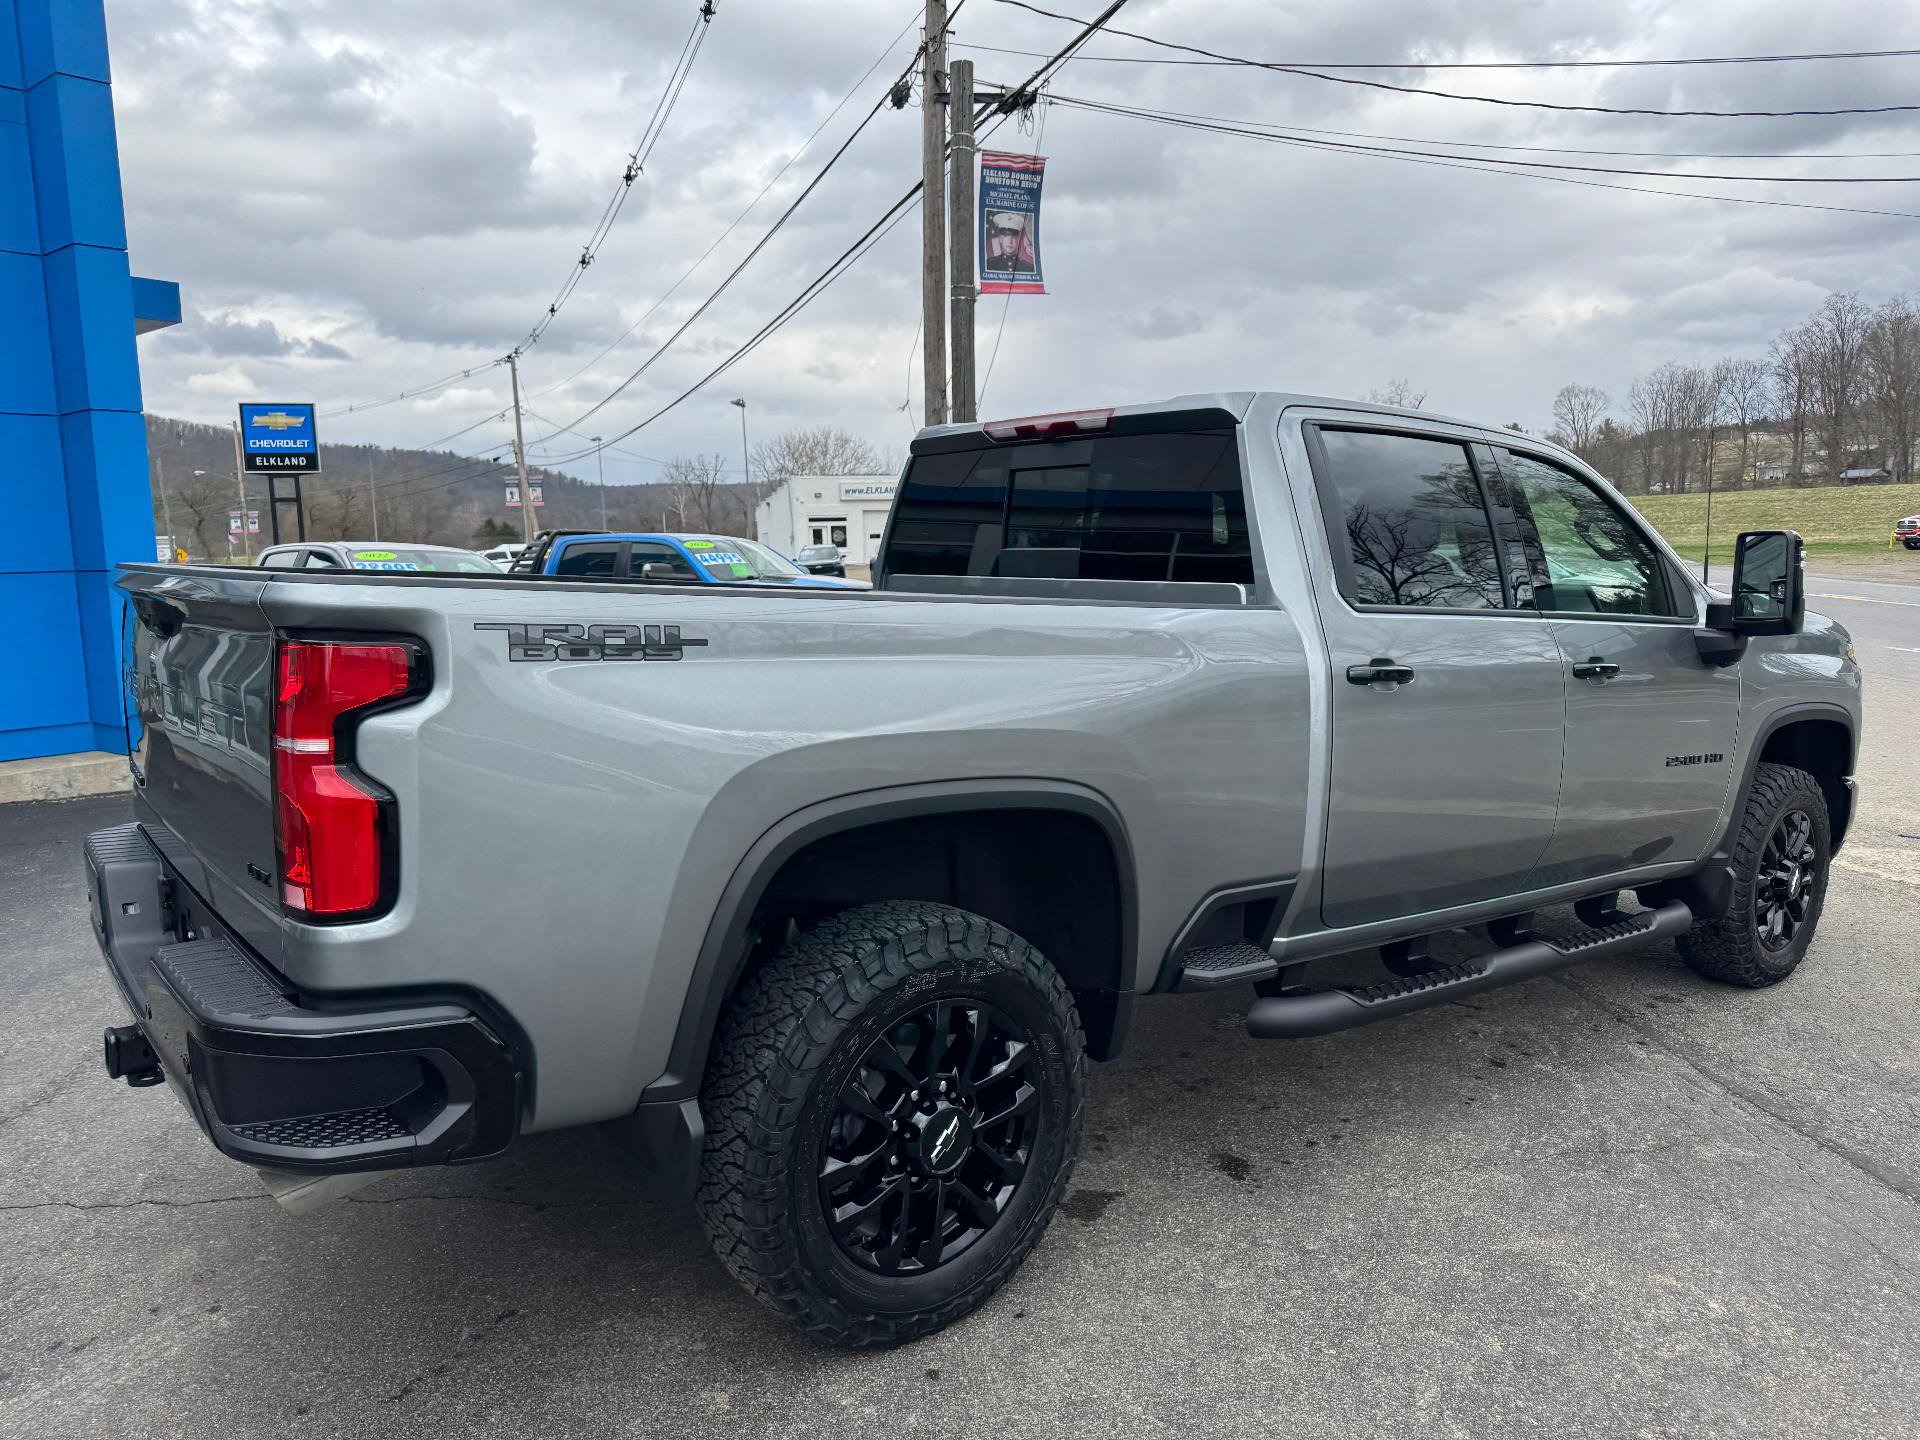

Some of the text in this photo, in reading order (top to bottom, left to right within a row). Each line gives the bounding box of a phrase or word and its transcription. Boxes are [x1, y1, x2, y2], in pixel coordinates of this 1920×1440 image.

[983, 169, 1010, 178] ELKLAND
[985, 176, 1038, 189] HOMETOWN HERO
[996, 200, 1016, 208] MARINE
[249, 439, 310, 448] CHEVROLET
[255, 456, 307, 466] ELKLAND
[699, 553, 743, 563] 44995
[474, 623, 708, 646] TRAIL
[509, 644, 683, 662] BOSS
[1665, 753, 1724, 767] 2500 HD
